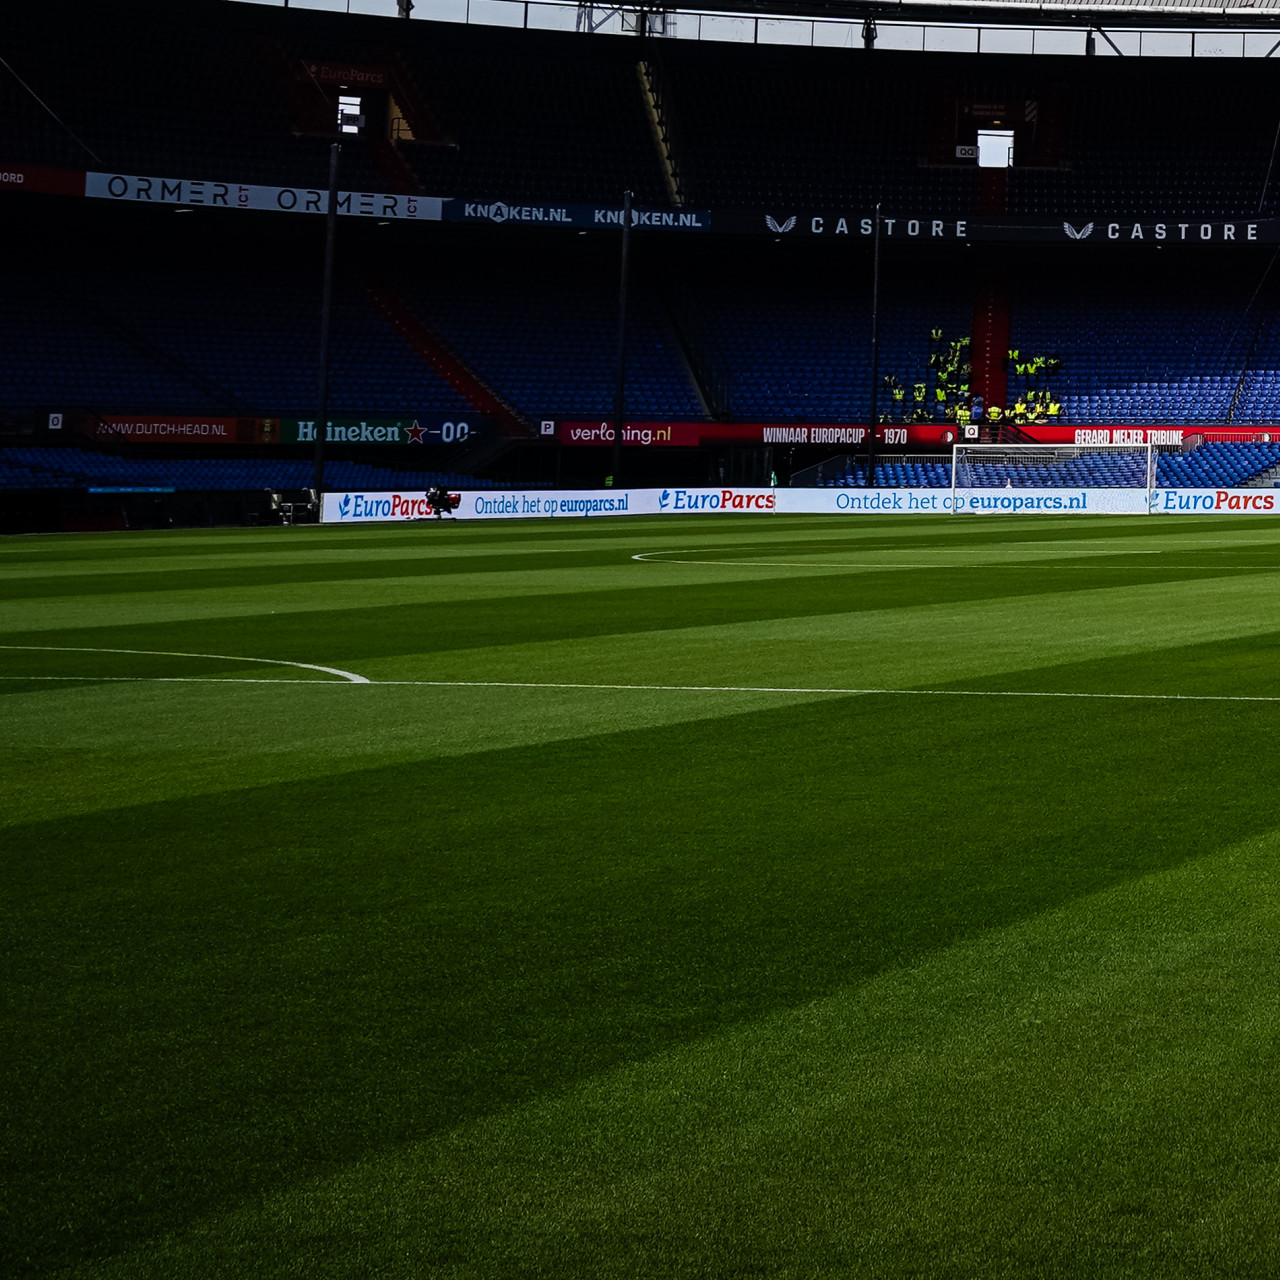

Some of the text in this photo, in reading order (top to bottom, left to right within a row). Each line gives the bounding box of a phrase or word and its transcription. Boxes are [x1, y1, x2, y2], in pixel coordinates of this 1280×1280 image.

[321, 66, 385, 83] EuroParcs
[960, 148, 974, 156] QQ
[108, 175, 228, 205] ORMER
[277, 189, 398, 216] ORMER
[464, 202, 572, 222] KNAKEN.NL
[594, 208, 702, 229] KNKEN.NL
[811, 217, 967, 237] CASTORE
[1107, 223, 1257, 240] CASTORE
[97, 423, 227, 436] WWW.DUTCH-HEAD.NL
[763, 427, 808, 443] WINNAAR
[810, 427, 865, 443] EUROPACUP
[884, 428, 907, 444] 1970
[1075, 429, 1183, 445] GERARD MEIJER TRIBUNE
[352, 494, 433, 517] EuroParcs
[475, 494, 628, 517] Ontdek het op europarcs.nl
[673, 490, 776, 509] EuroParcs
[836, 493, 902, 509] Ontdek
[908, 493, 938, 509] het
[970, 493, 1088, 512] europarcs.nl
[1164, 491, 1274, 510] EuroParcs
